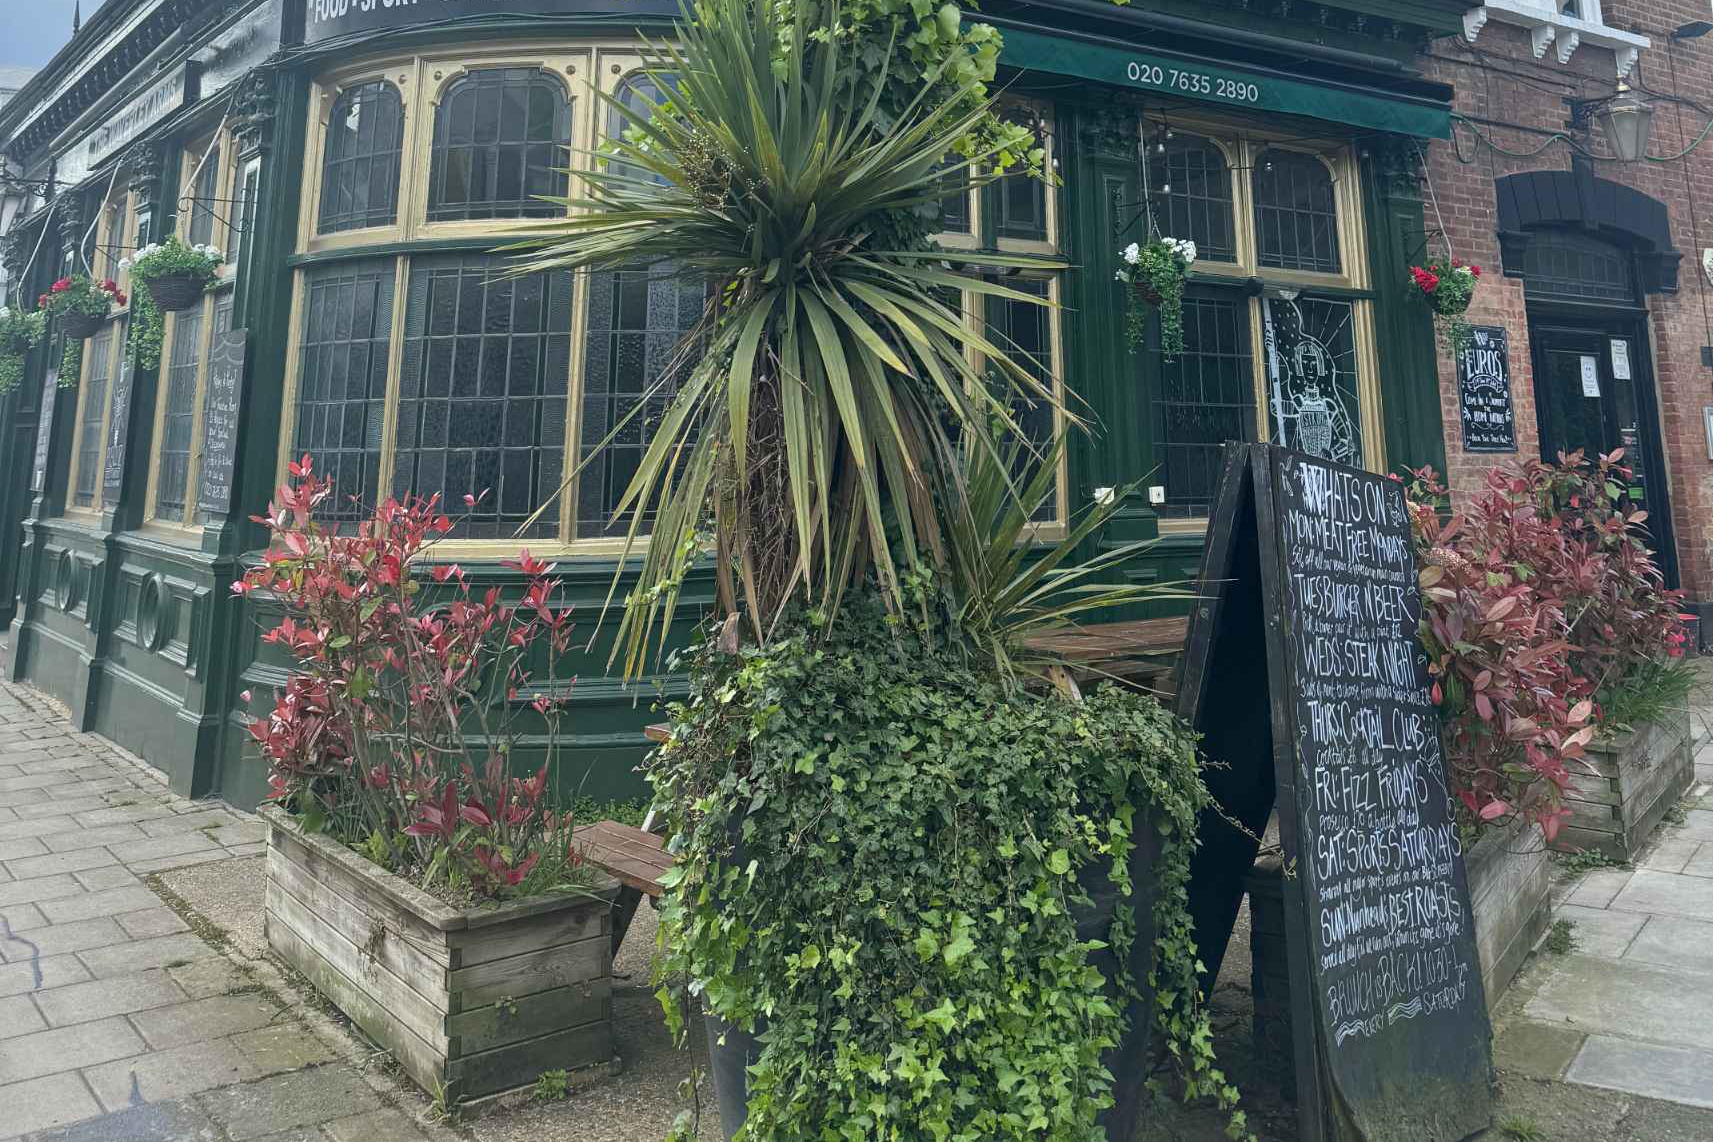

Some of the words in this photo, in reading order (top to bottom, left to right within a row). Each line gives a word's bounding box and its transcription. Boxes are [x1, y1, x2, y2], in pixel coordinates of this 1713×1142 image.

[1127, 62, 1164, 85] 020
[1168, 69, 1211, 94] 7635
[1216, 78, 1259, 102] 2890
[1465, 348, 1503, 382] EUROS
[1300, 462, 1362, 522] WHATS
[1364, 480, 1387, 526] ON
[1345, 523, 1369, 564] FREE
[1323, 575, 1364, 625] BURGER
[1373, 584, 1416, 626] BEER
[1344, 637, 1386, 684] STEAK
[1381, 639, 1416, 691] NIGHT
[1345, 827, 1391, 875] SPORTS
[1388, 822, 1462, 871] SATURDAYS
[1328, 969, 1375, 1027] BRUNCH
